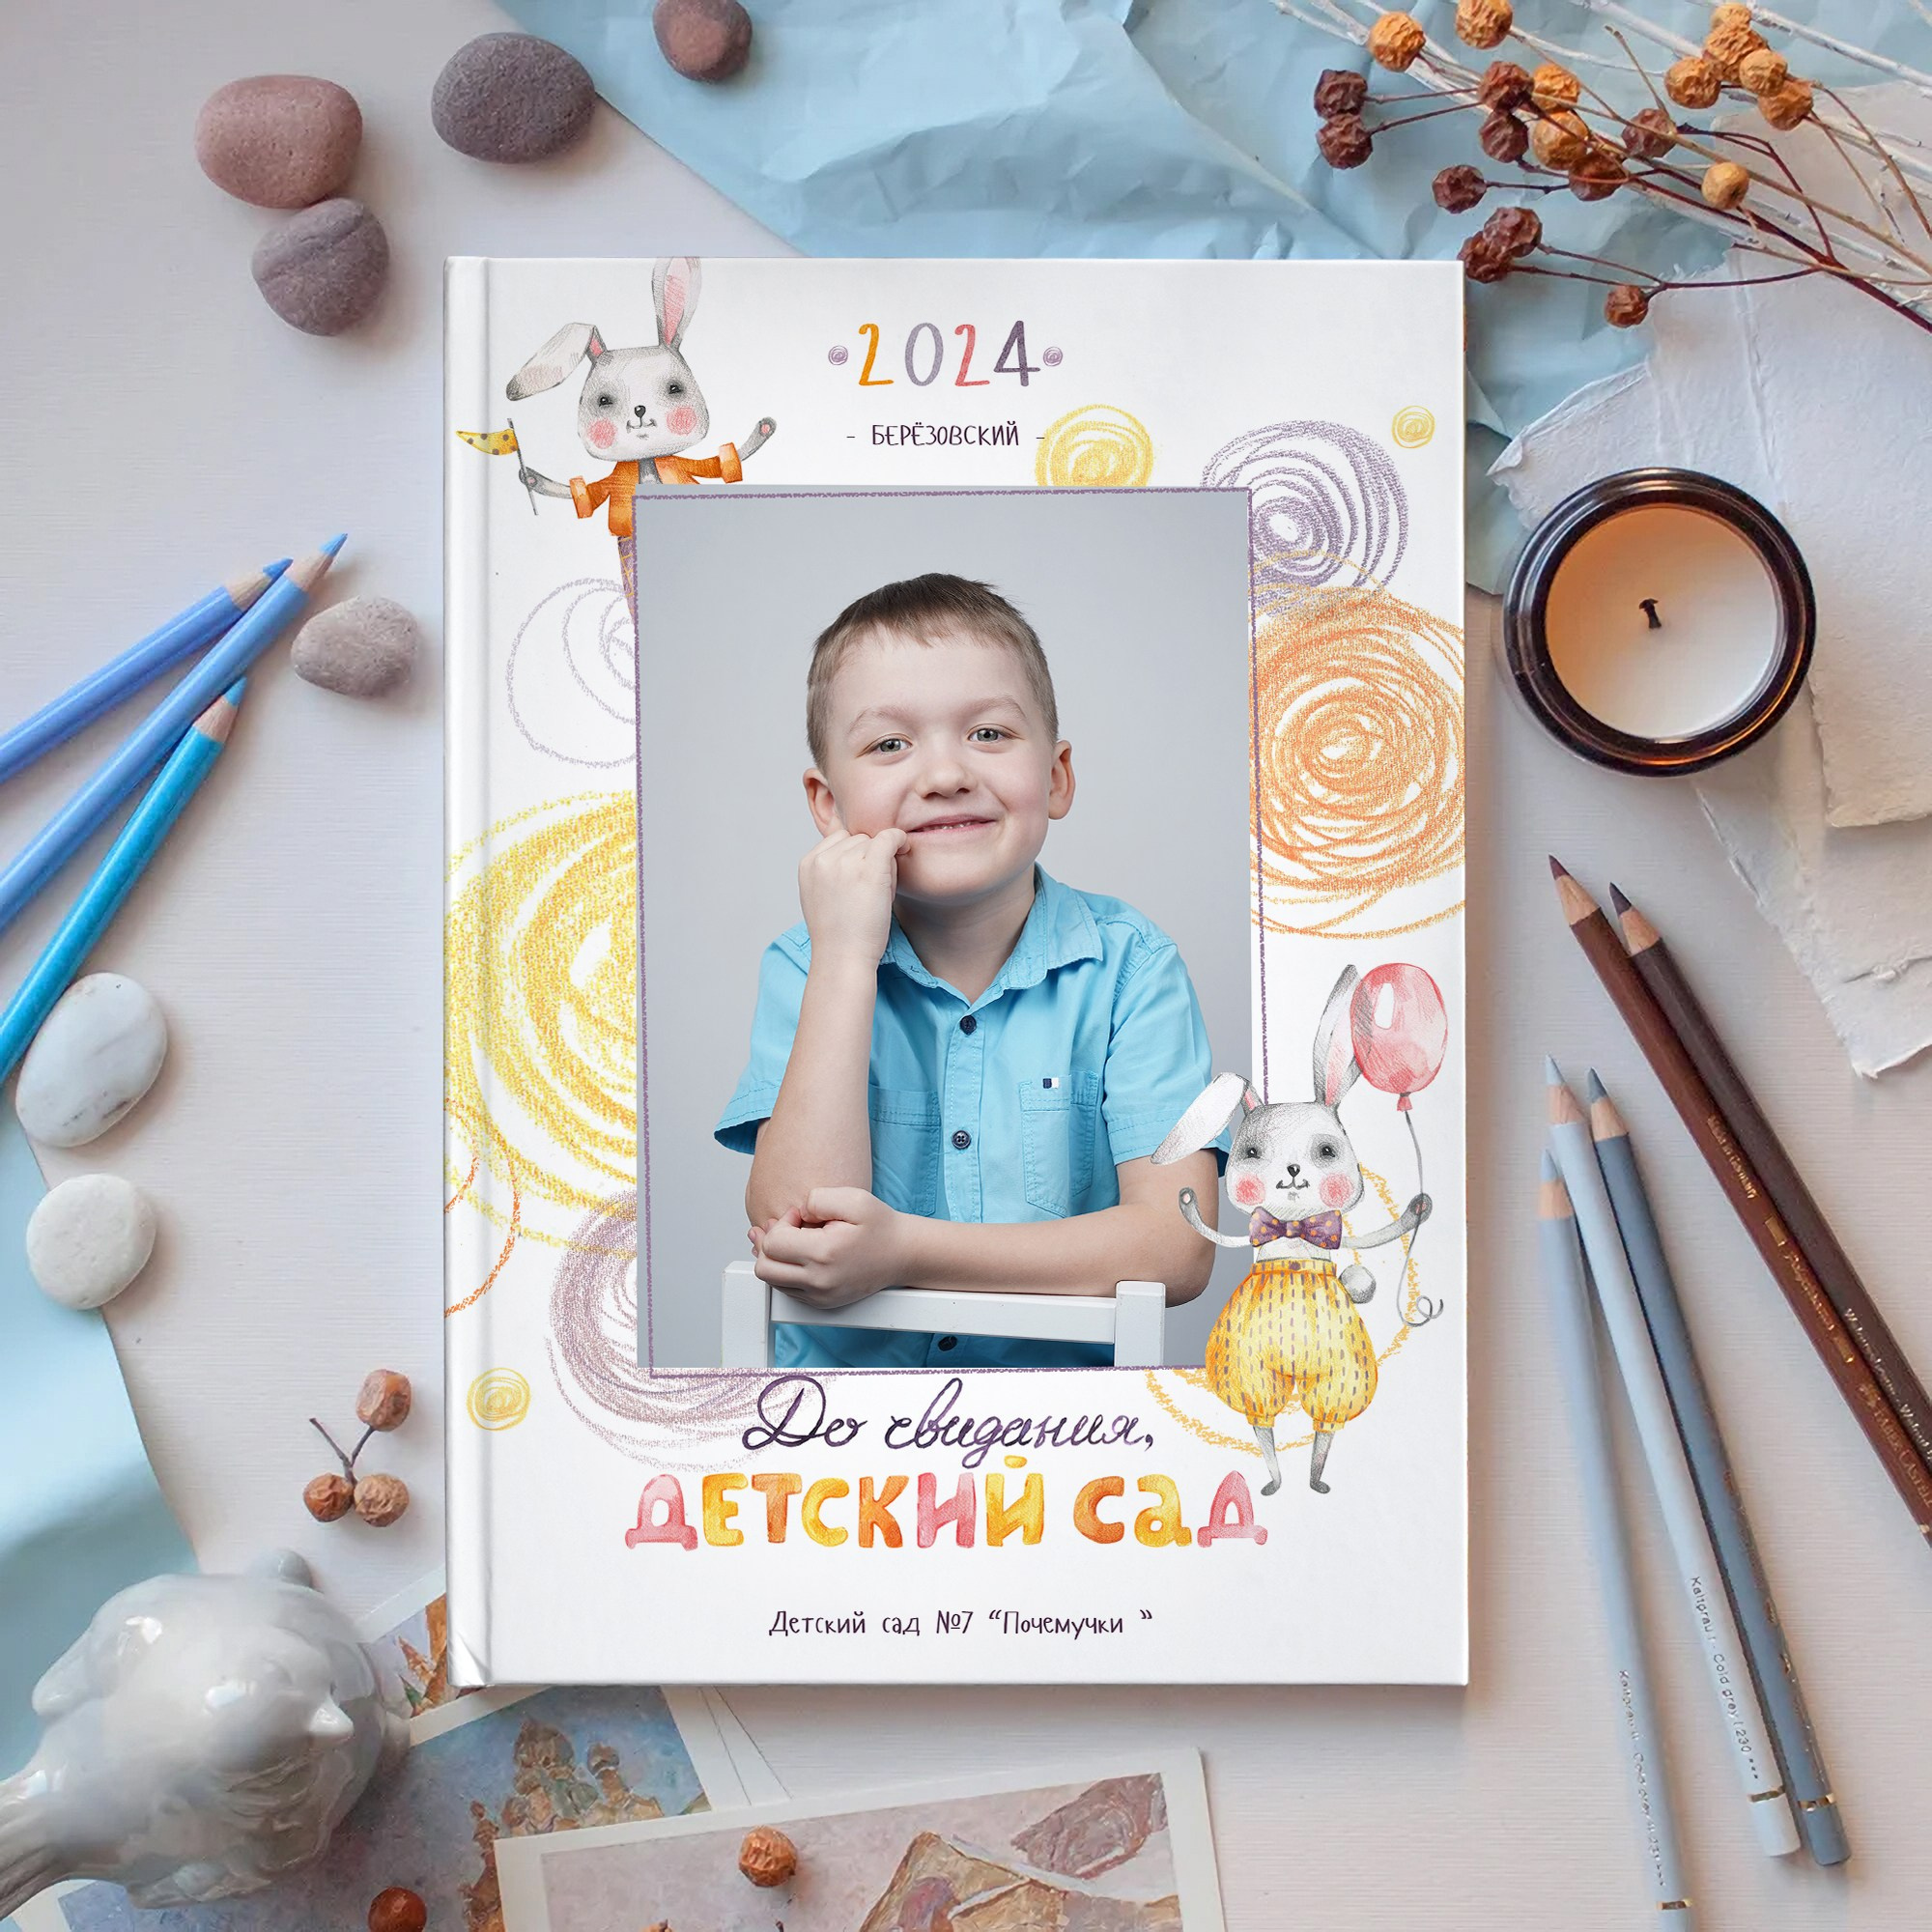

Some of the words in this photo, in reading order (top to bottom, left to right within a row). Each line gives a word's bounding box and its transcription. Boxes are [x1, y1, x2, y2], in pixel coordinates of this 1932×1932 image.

[858, 320, 1041, 387] 2024
[871, 420, 1019, 446] БЕРЁЗОВСКИЙ
[742, 1374, 868, 1451] До
[884, 1377, 1154, 1469] свидания,
[625, 1455, 1045, 1551] ДЕТСКИЙ
[769, 1610, 866, 1637] Детский
[882, 1616, 921, 1636] сад
[935, 1610, 974, 1634] №7
[1690, 1576, 1715, 1633] Kaltgrau
[1713, 1653, 1730, 1685] Cold
[1722, 1689, 1740, 1719] grey
[1736, 1728, 1752, 1753] 230
